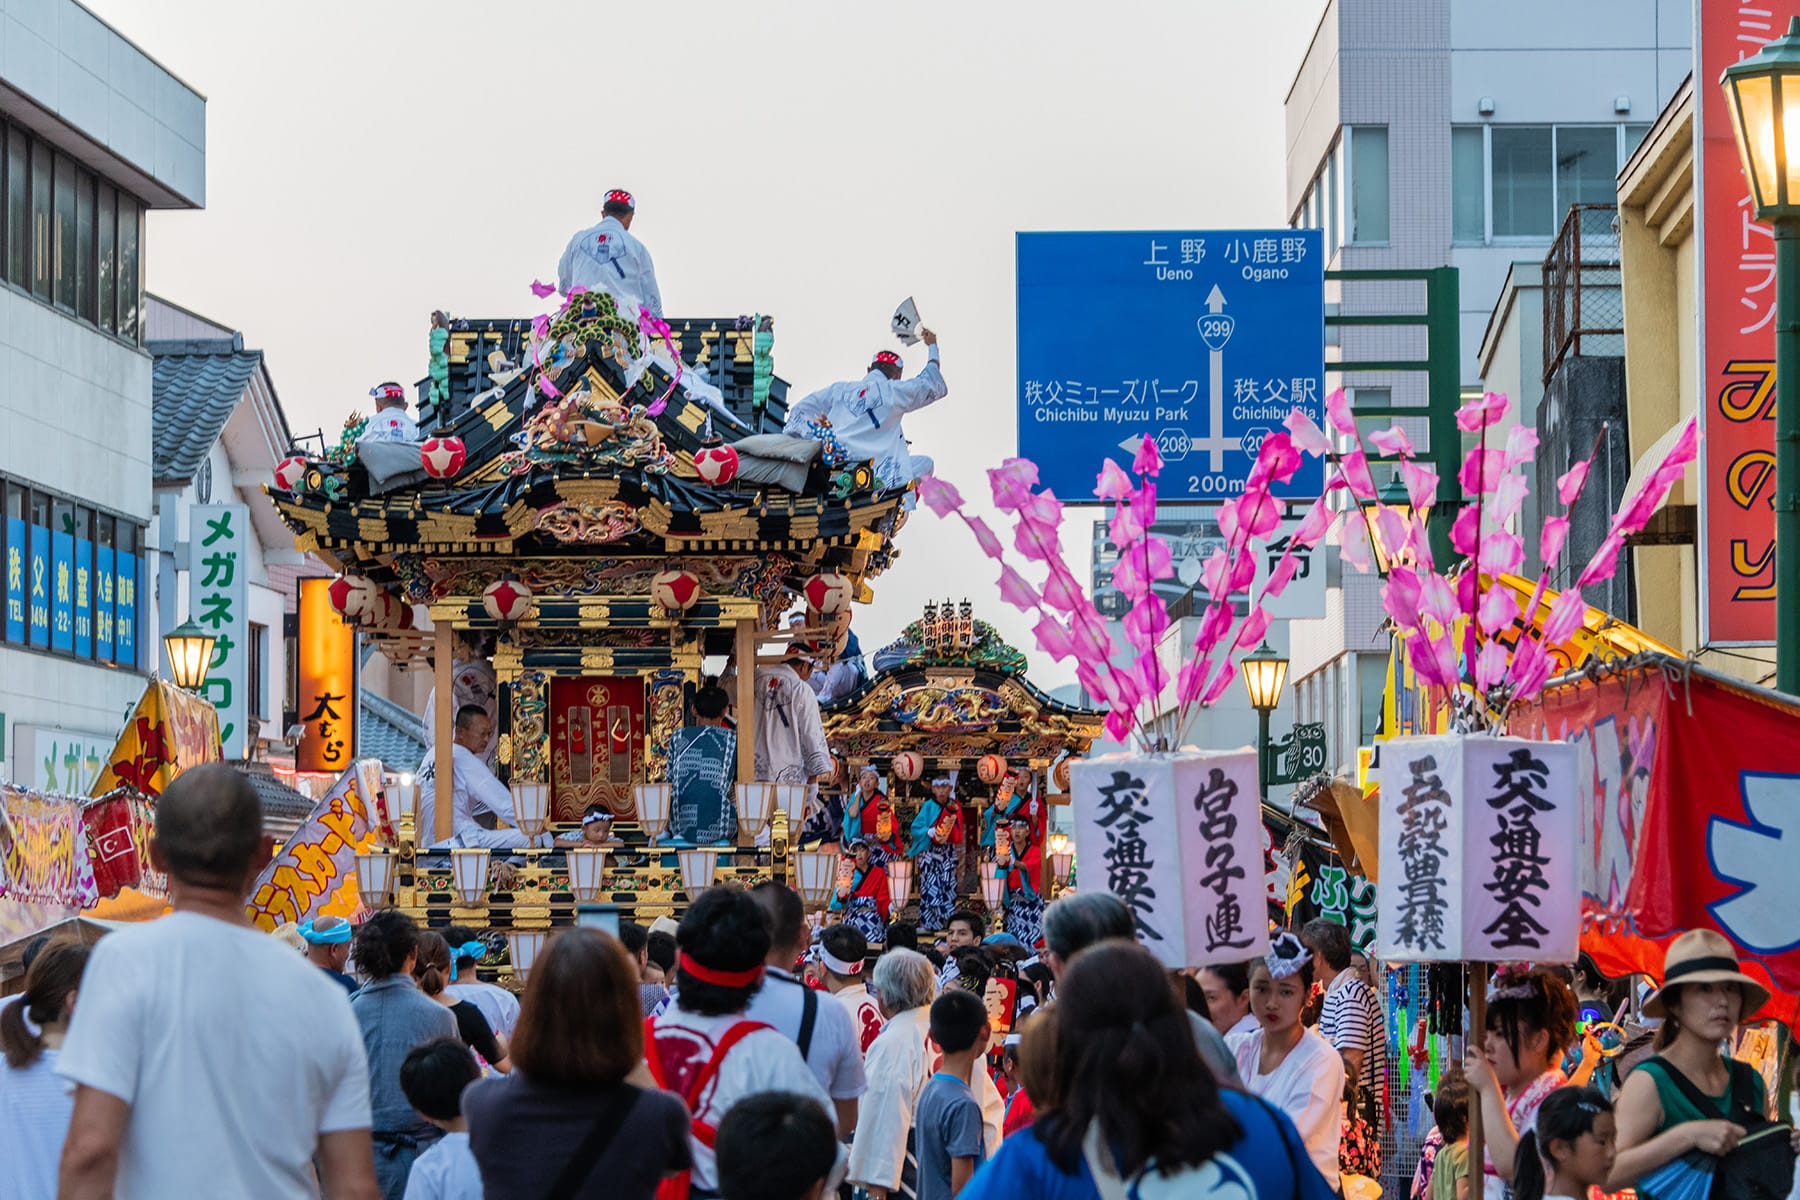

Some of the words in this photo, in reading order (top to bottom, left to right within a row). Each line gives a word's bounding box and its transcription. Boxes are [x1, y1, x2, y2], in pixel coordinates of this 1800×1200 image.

[1143, 239, 1206, 265] 上野
[1224, 238, 1307, 264] 小鹿野
[1156, 266, 1193, 281] Ueno
[1242, 265, 1289, 283] Ogano
[1203, 321, 1230, 338] 299
[1025, 378, 1199, 406] 秩父ミューズパーク
[1233, 378, 1317, 404] 秩父駅
[1035, 407, 1098, 422] Chichibu
[1104, 407, 1150, 424] Myuzu
[1155, 407, 1189, 421] Park
[1232, 405, 1288, 420] Chichibu
[1160, 436, 1187, 453] 208
[1247, 435, 1265, 452] 20
[1188, 475, 1245, 493] 200m
[8, 598, 24, 622] TEL
[303, 692, 346, 763] 大むら
[1302, 745, 1323, 768] 30
[1482, 748, 1557, 950] 交通安全
